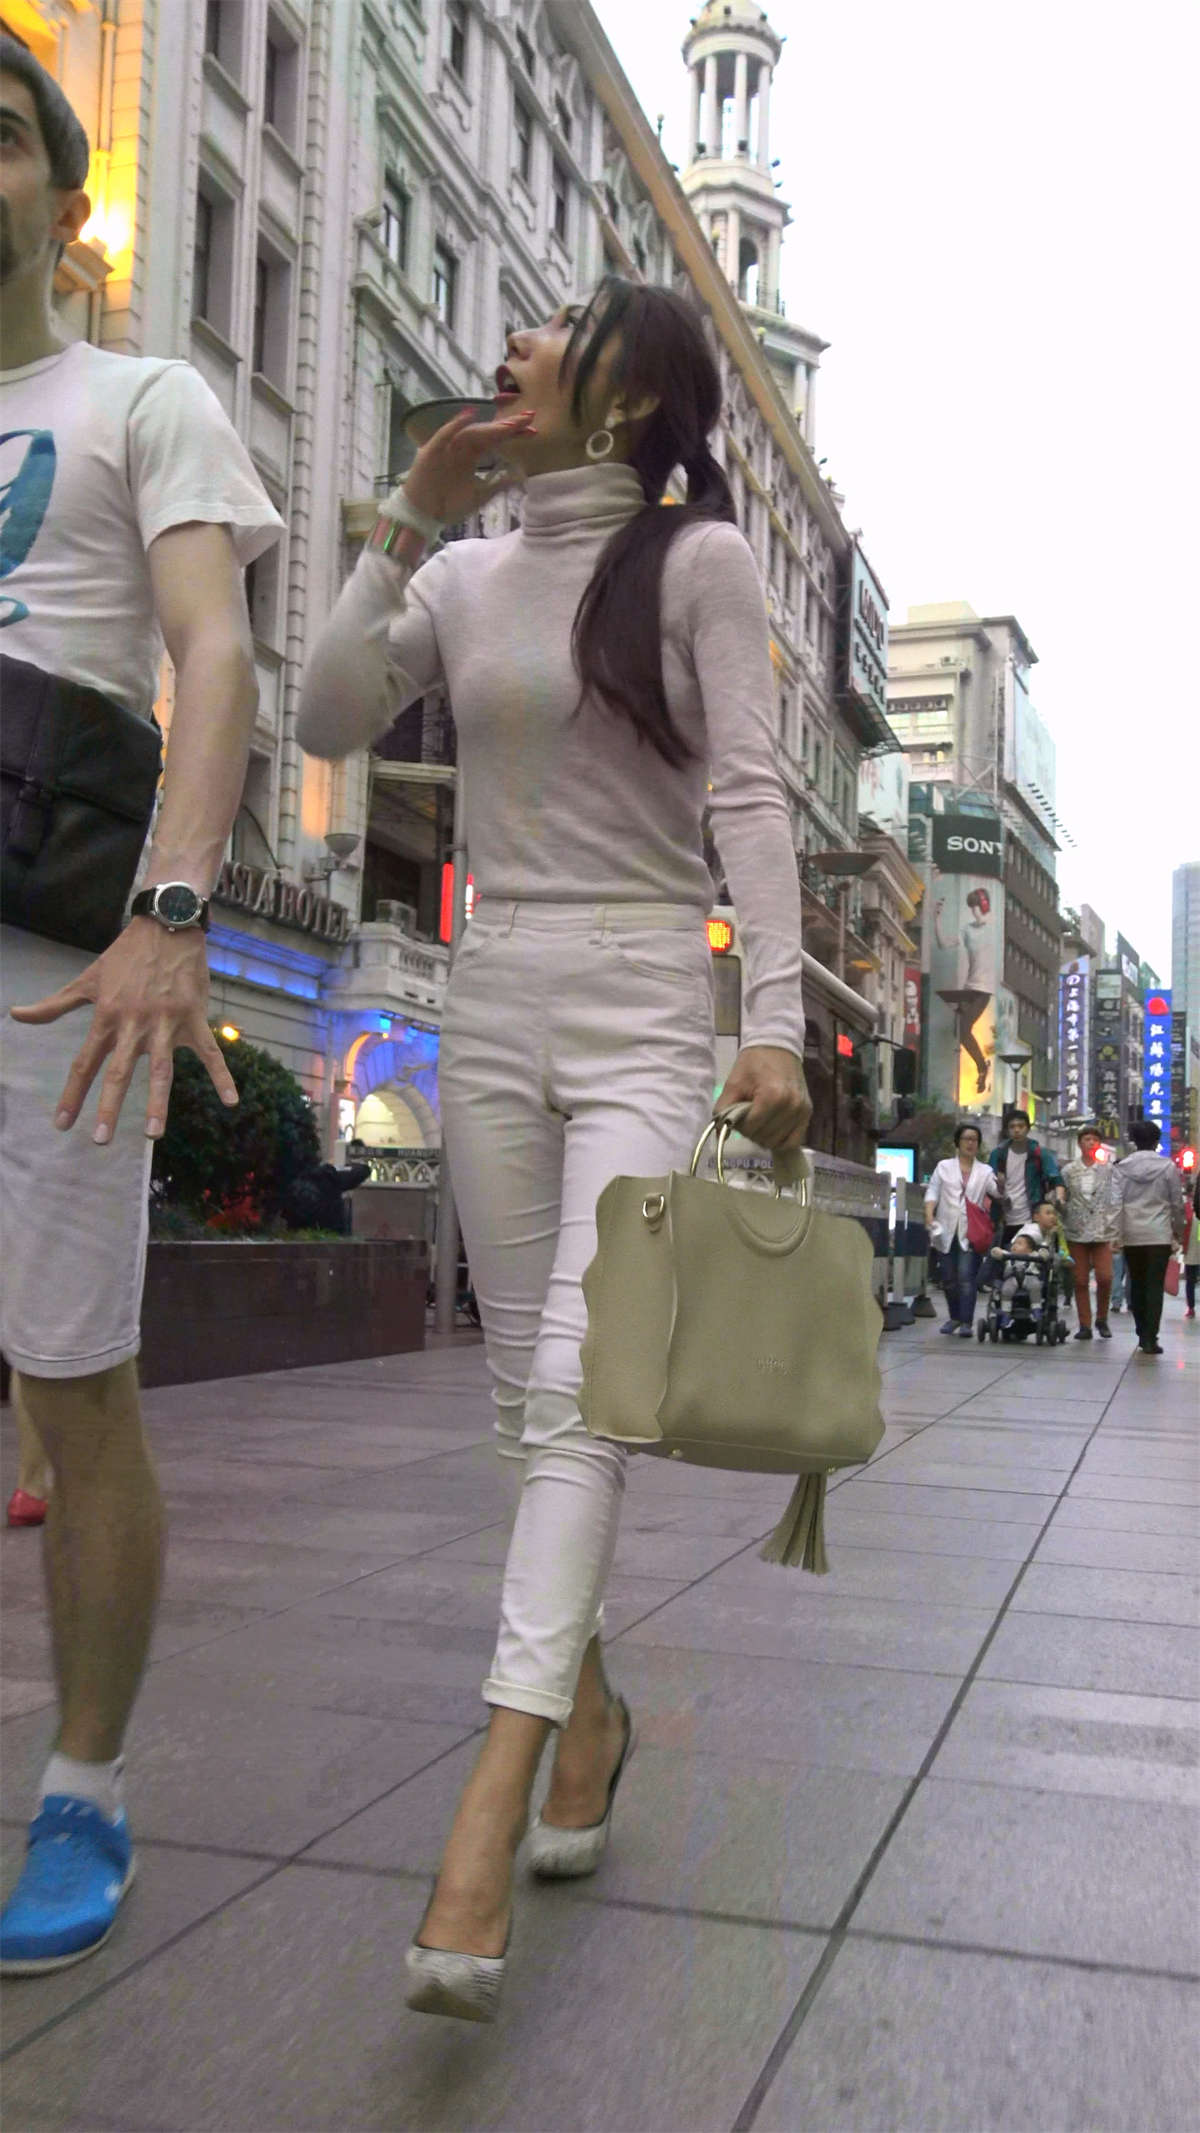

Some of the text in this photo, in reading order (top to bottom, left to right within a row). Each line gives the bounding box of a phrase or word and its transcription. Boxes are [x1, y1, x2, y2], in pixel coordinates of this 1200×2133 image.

[947, 836, 1004, 856] SONY
[212, 857, 352, 942] ASIA HOTEL
